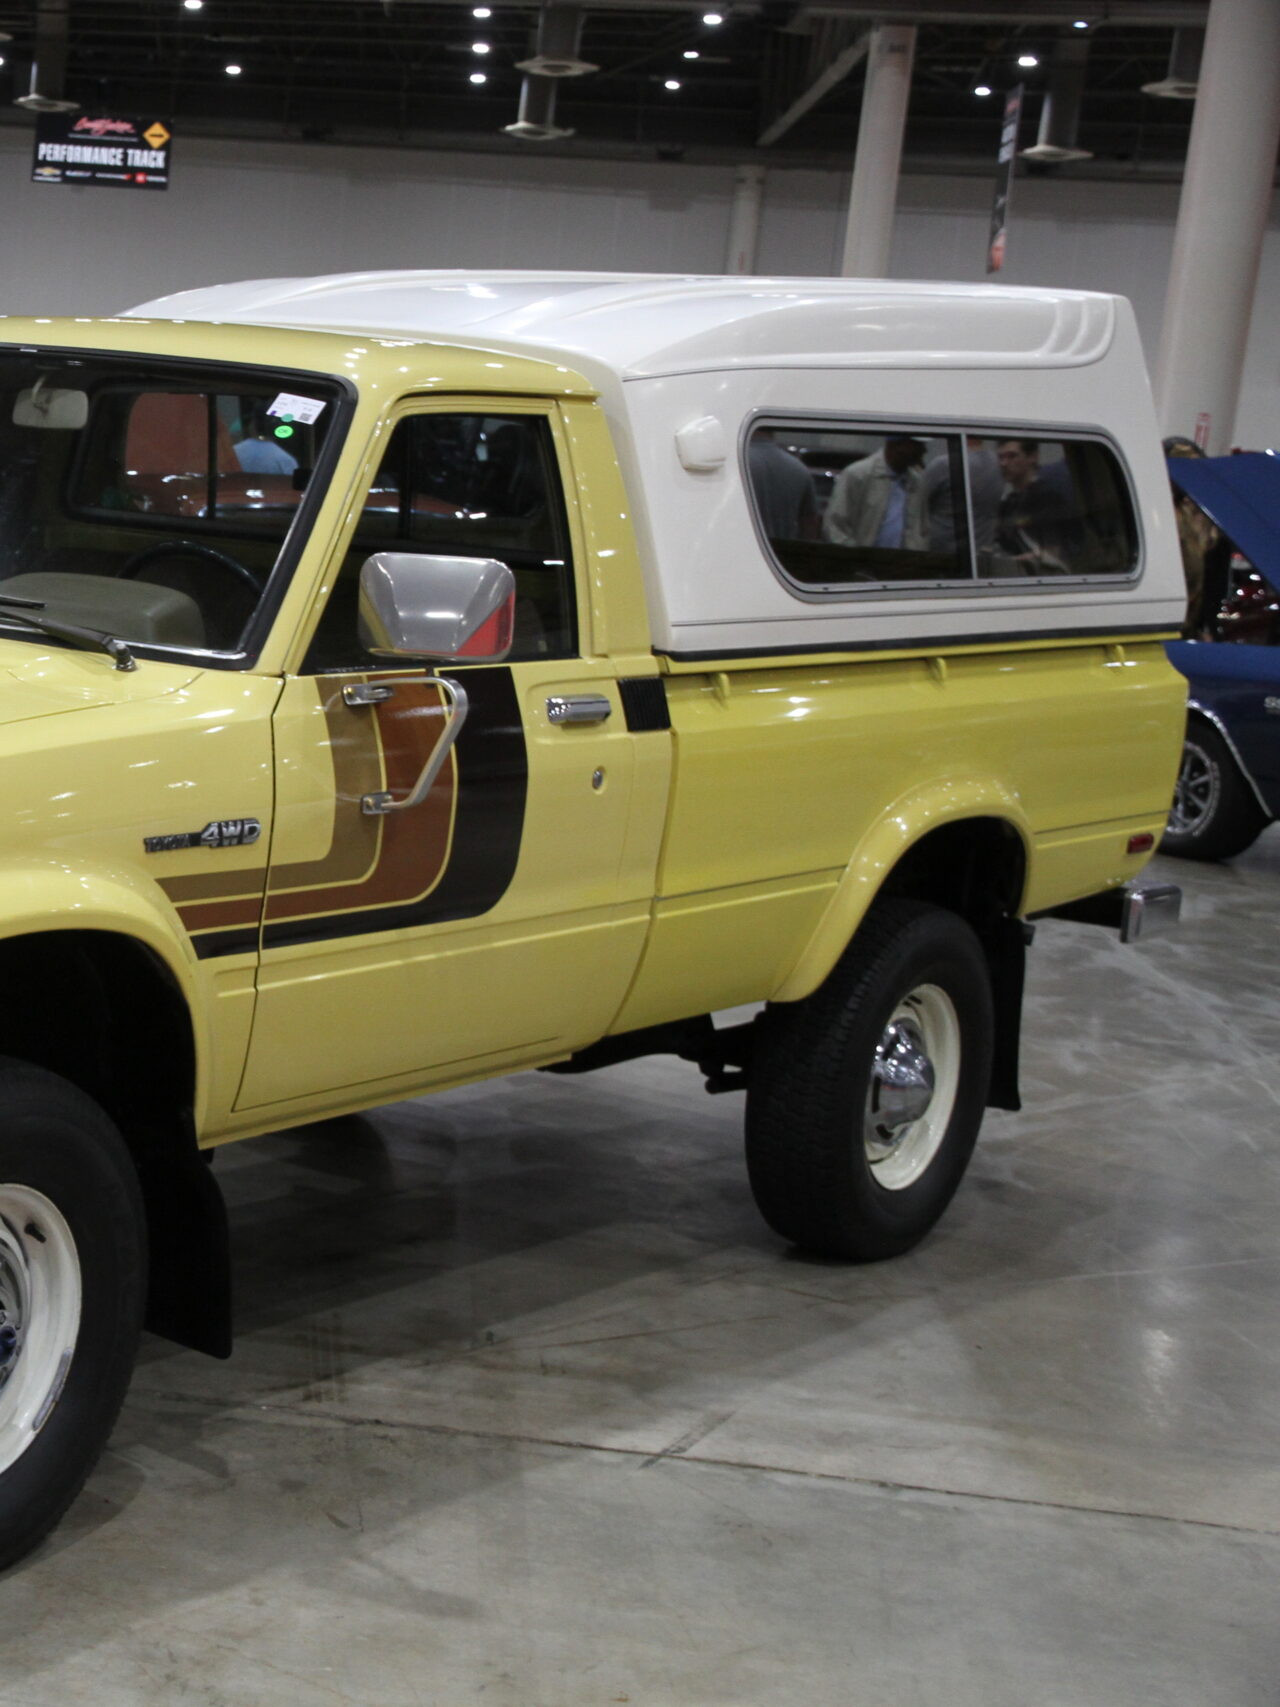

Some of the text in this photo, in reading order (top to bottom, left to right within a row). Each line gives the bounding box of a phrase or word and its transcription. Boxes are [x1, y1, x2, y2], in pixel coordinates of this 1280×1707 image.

[38, 143, 166, 169] PERFORMANCE TRACK
[200, 818, 261, 848] 4WD
